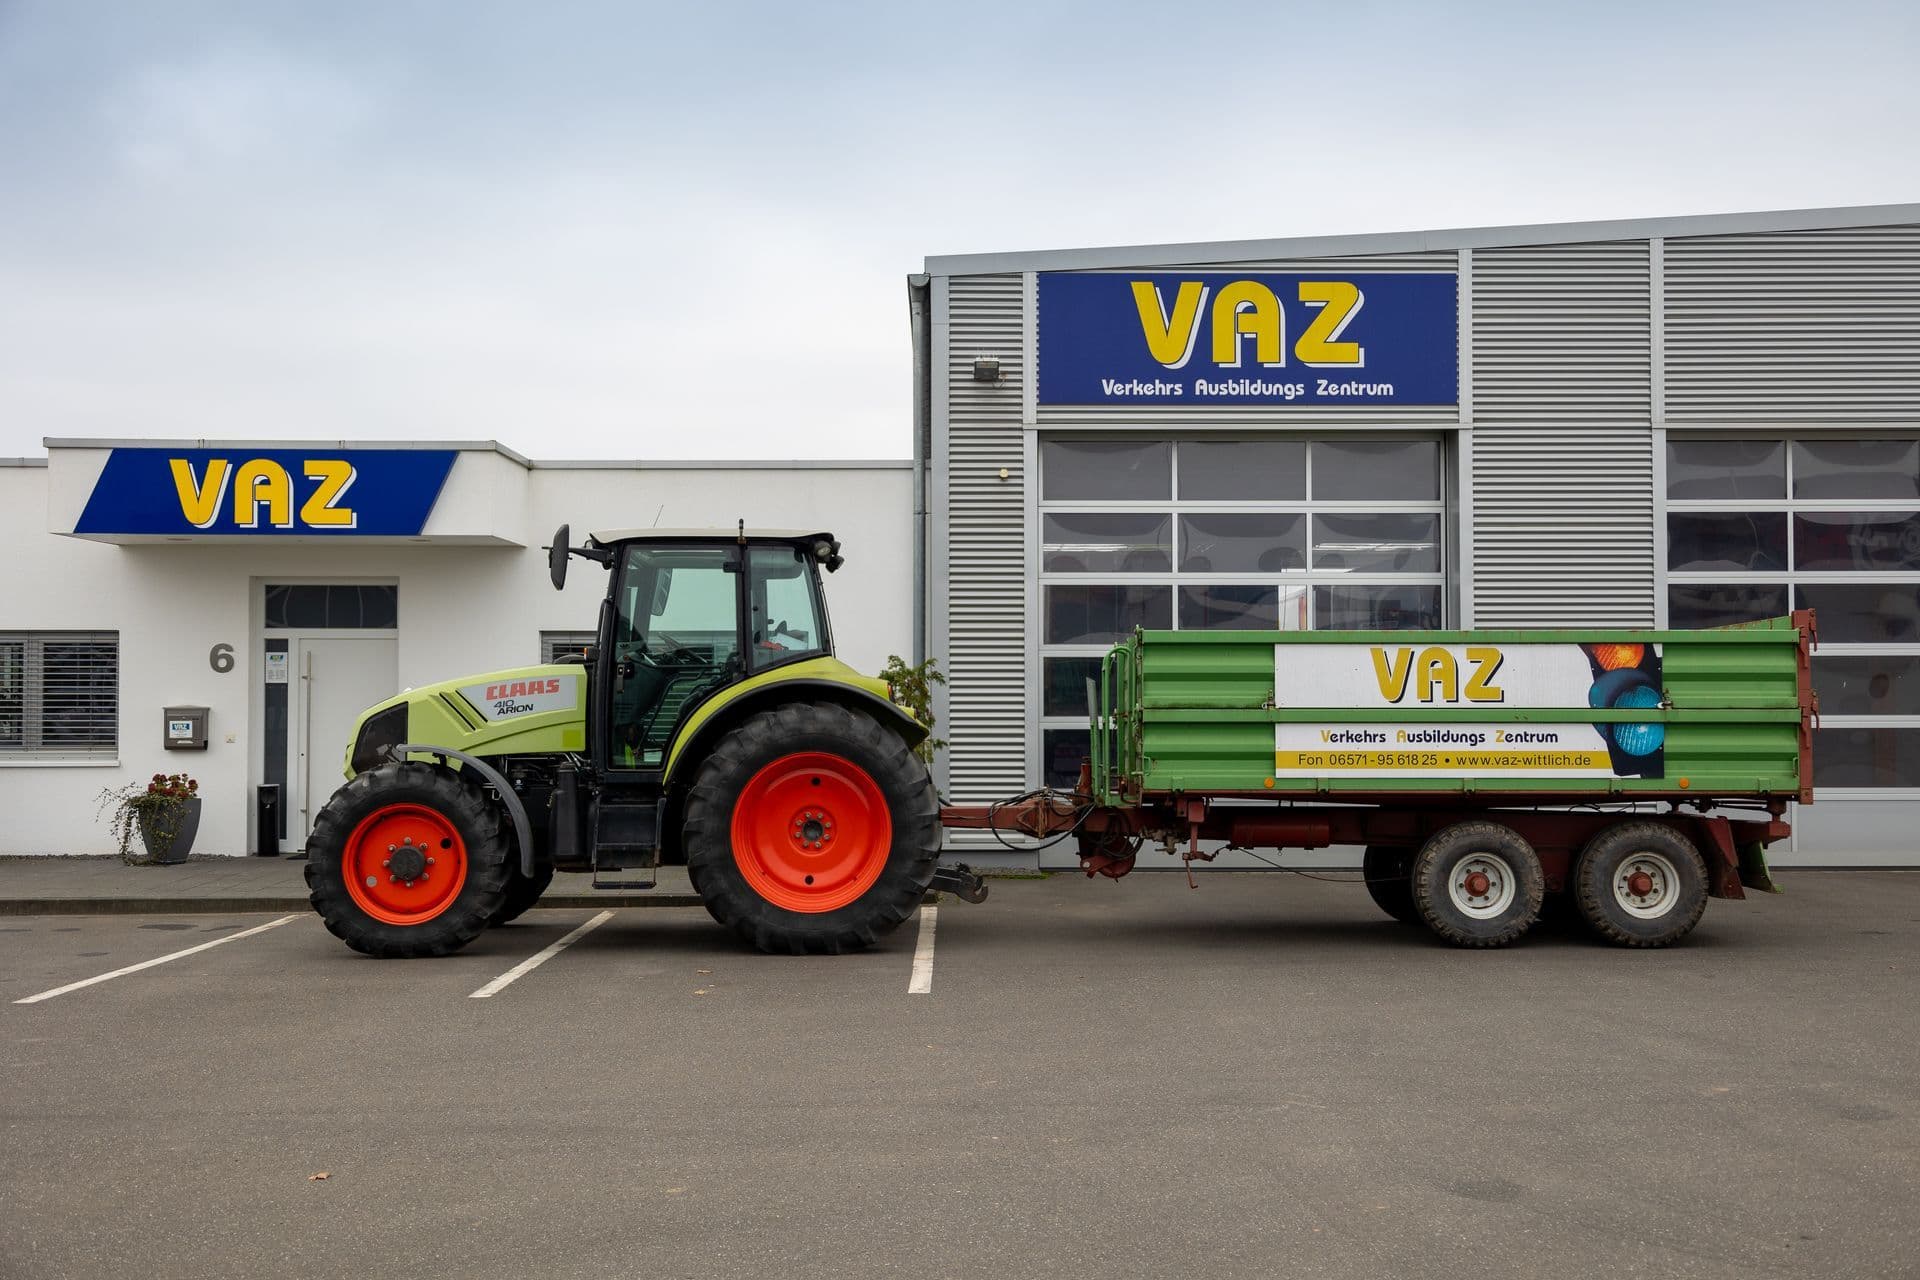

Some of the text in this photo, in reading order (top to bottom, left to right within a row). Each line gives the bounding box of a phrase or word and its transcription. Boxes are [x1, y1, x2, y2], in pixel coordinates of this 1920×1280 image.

[1130, 280, 1365, 369] VAZ
[1102, 379, 1394, 400] Verkehrs Ausbildungs Zentrum
[169, 459, 357, 528] VAZ
[209, 643, 234, 673] 6
[1370, 647, 1504, 703] VAZ
[486, 679, 560, 700] CLAAS
[494, 700, 515, 709] 410
[497, 704, 534, 716] ARION
[1320, 729, 1559, 746] Verkehrs Ausbildungs Zentrum
[1298, 754, 1323, 766] Fon
[1456, 754, 1591, 766] www.vaz-wittlich.de
